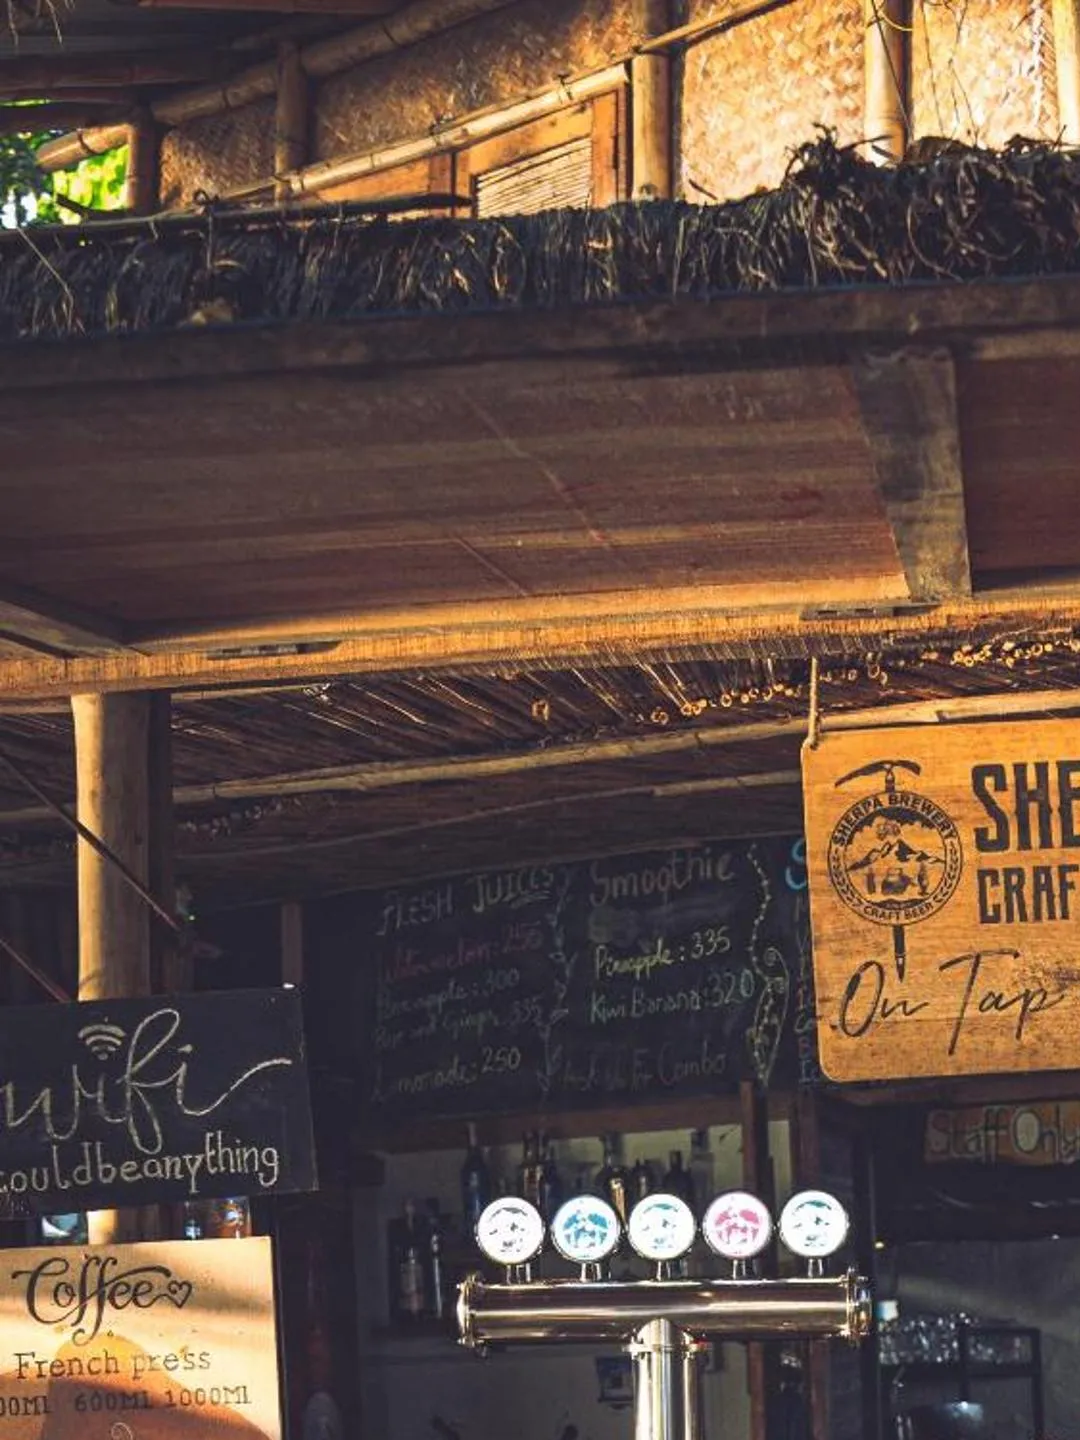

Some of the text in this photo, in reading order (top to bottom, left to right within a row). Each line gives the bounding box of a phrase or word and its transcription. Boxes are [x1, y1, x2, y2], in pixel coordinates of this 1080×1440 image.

[832, 793, 957, 846] SHERPA BREWERY
[589, 846, 738, 906] Smoothie
[863, 902, 934, 921] CRAFT BEER
[832, 959, 930, 1038] On
[938, 946, 1072, 1056] Tap
[11, 1254, 173, 1347] Coffee
[13, 1348, 213, 1381] French press
